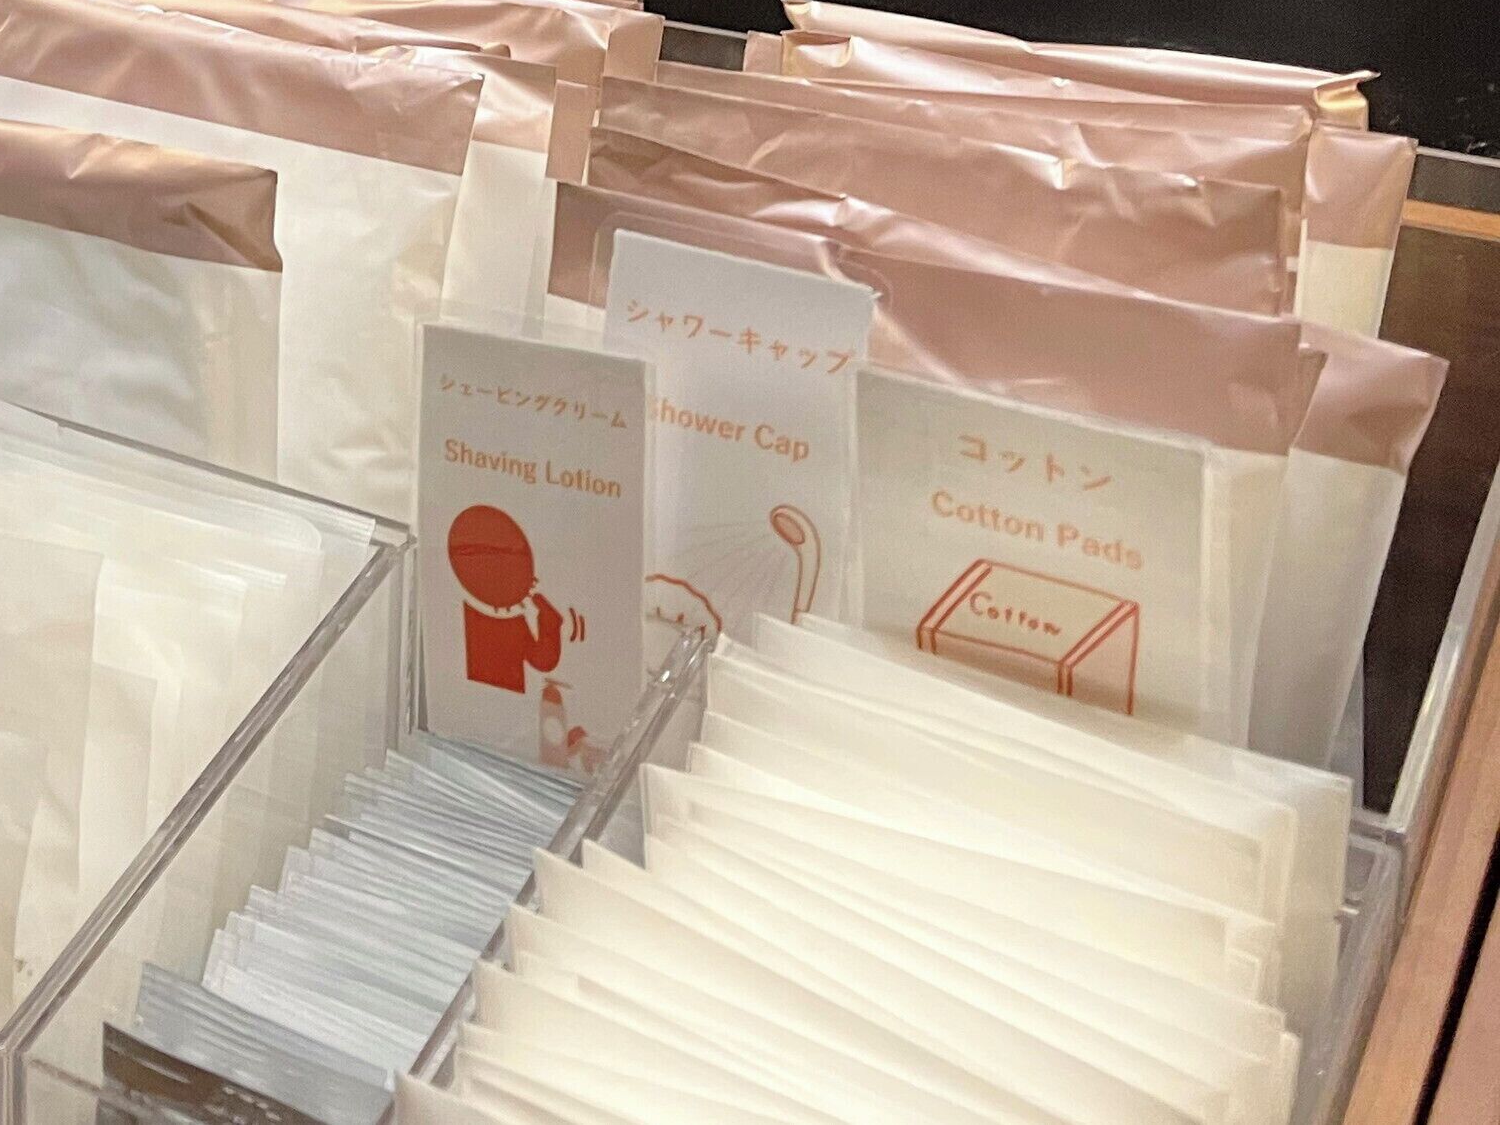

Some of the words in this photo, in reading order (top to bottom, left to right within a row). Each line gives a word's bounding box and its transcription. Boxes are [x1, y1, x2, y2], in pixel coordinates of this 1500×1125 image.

[626, 298, 854, 375] シャワーキャップ
[439, 374, 628, 429] シェービングクリーム
[444, 437, 537, 485] Shaving
[545, 458, 622, 500] Lotion
[753, 423, 810, 464] Cap
[957, 434, 1114, 492] コットン
[931, 489, 1045, 544] Cotton
[1056, 522, 1143, 571] Pads
